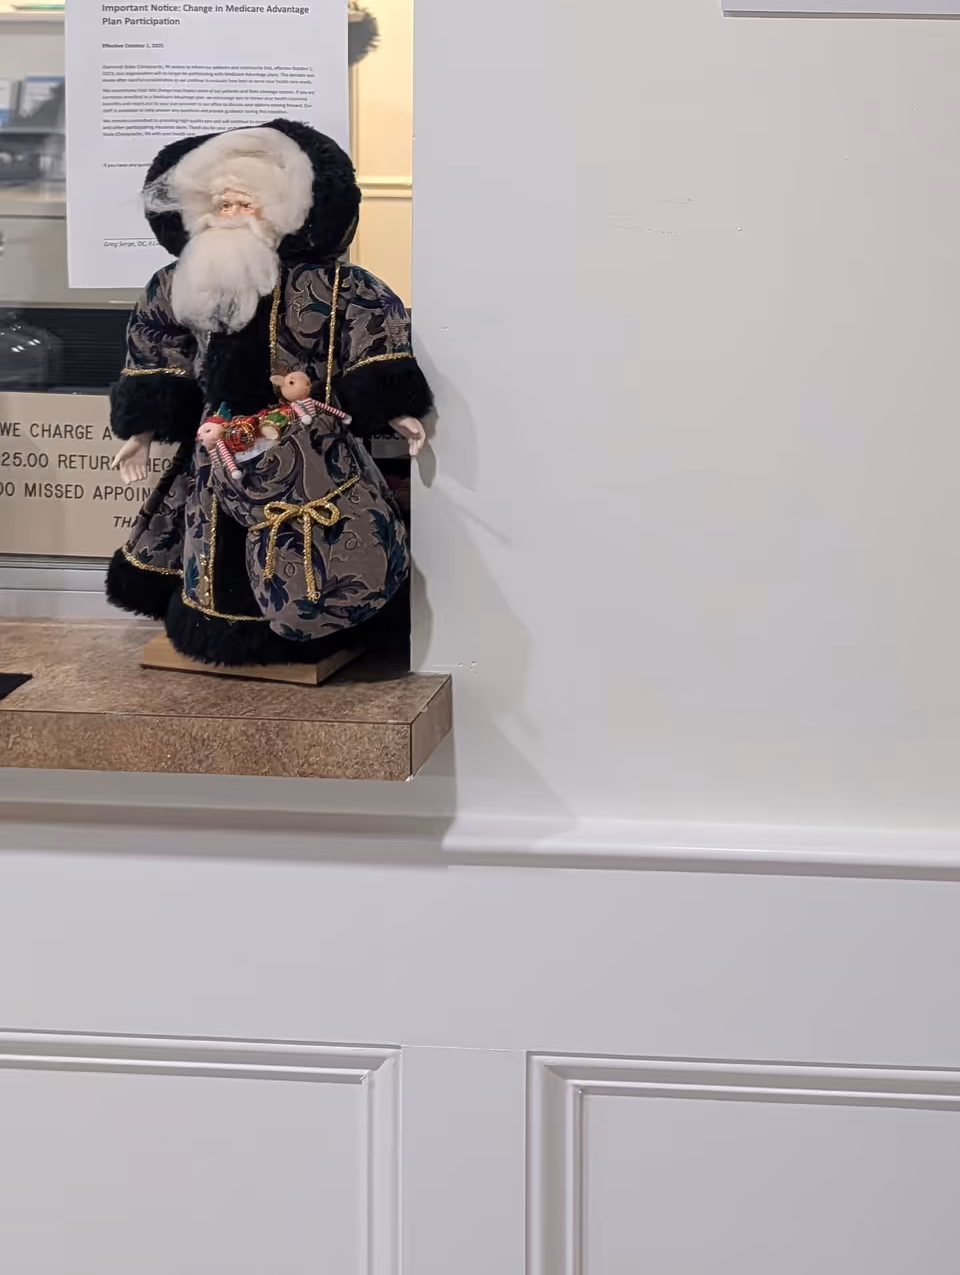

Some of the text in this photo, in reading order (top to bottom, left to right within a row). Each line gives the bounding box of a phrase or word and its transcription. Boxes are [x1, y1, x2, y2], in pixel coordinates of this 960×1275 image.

[102, 4, 148, 13] Important
[151, 4, 181, 12] Notice:
[183, 4, 213, 14] Change
[225, 5, 264, 13] Medicare
[266, 5, 310, 15] Advantage
[102, 17, 180, 26] Plan Participation
[0, 422, 21, 437] WE
[30, 423, 94, 440] CHARGE
[25, 482, 84, 499] MISSED
